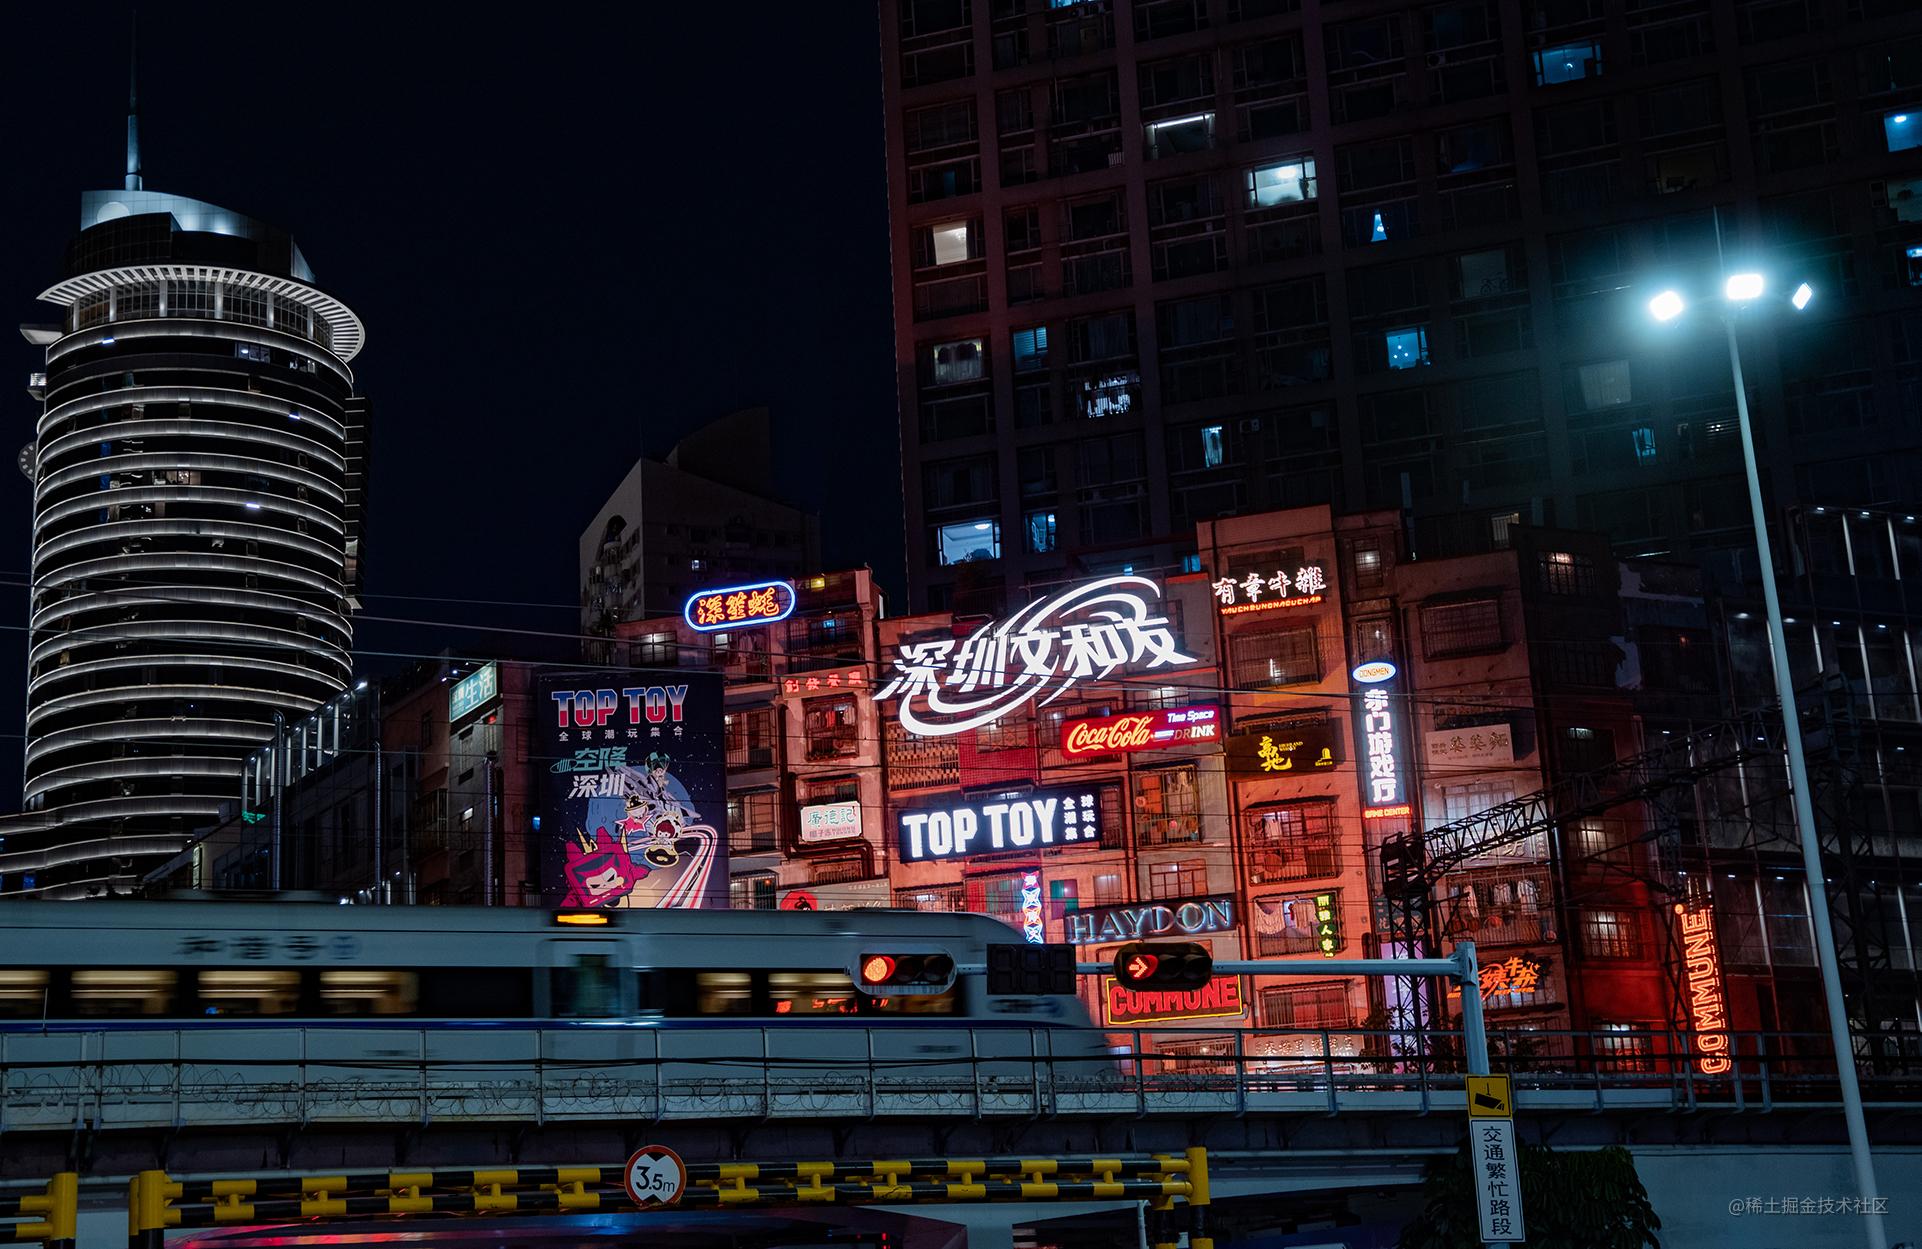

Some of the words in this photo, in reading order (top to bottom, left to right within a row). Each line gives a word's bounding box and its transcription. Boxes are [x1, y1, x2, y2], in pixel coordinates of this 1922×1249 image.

[872, 598, 1198, 712] 深圳文和友
[551, 689, 618, 728] TOP
[622, 685, 688, 724] TOY
[1167, 712, 1185, 723] Time
[1187, 710, 1215, 722] Space
[1174, 725, 1215, 740] DRINK
[1364, 688, 1397, 803] 东门游戏厅
[573, 746, 628, 772] 空降
[567, 773, 626, 799] 深圳
[902, 808, 978, 858] TOP
[983, 798, 1058, 849] TOY
[1065, 900, 1233, 944] HAYDON
[1681, 908, 1730, 1074] COMMUNE
[635, 1165, 675, 1193] 3.5m
[1483, 1126, 1512, 1236] 交通繁忙路段
